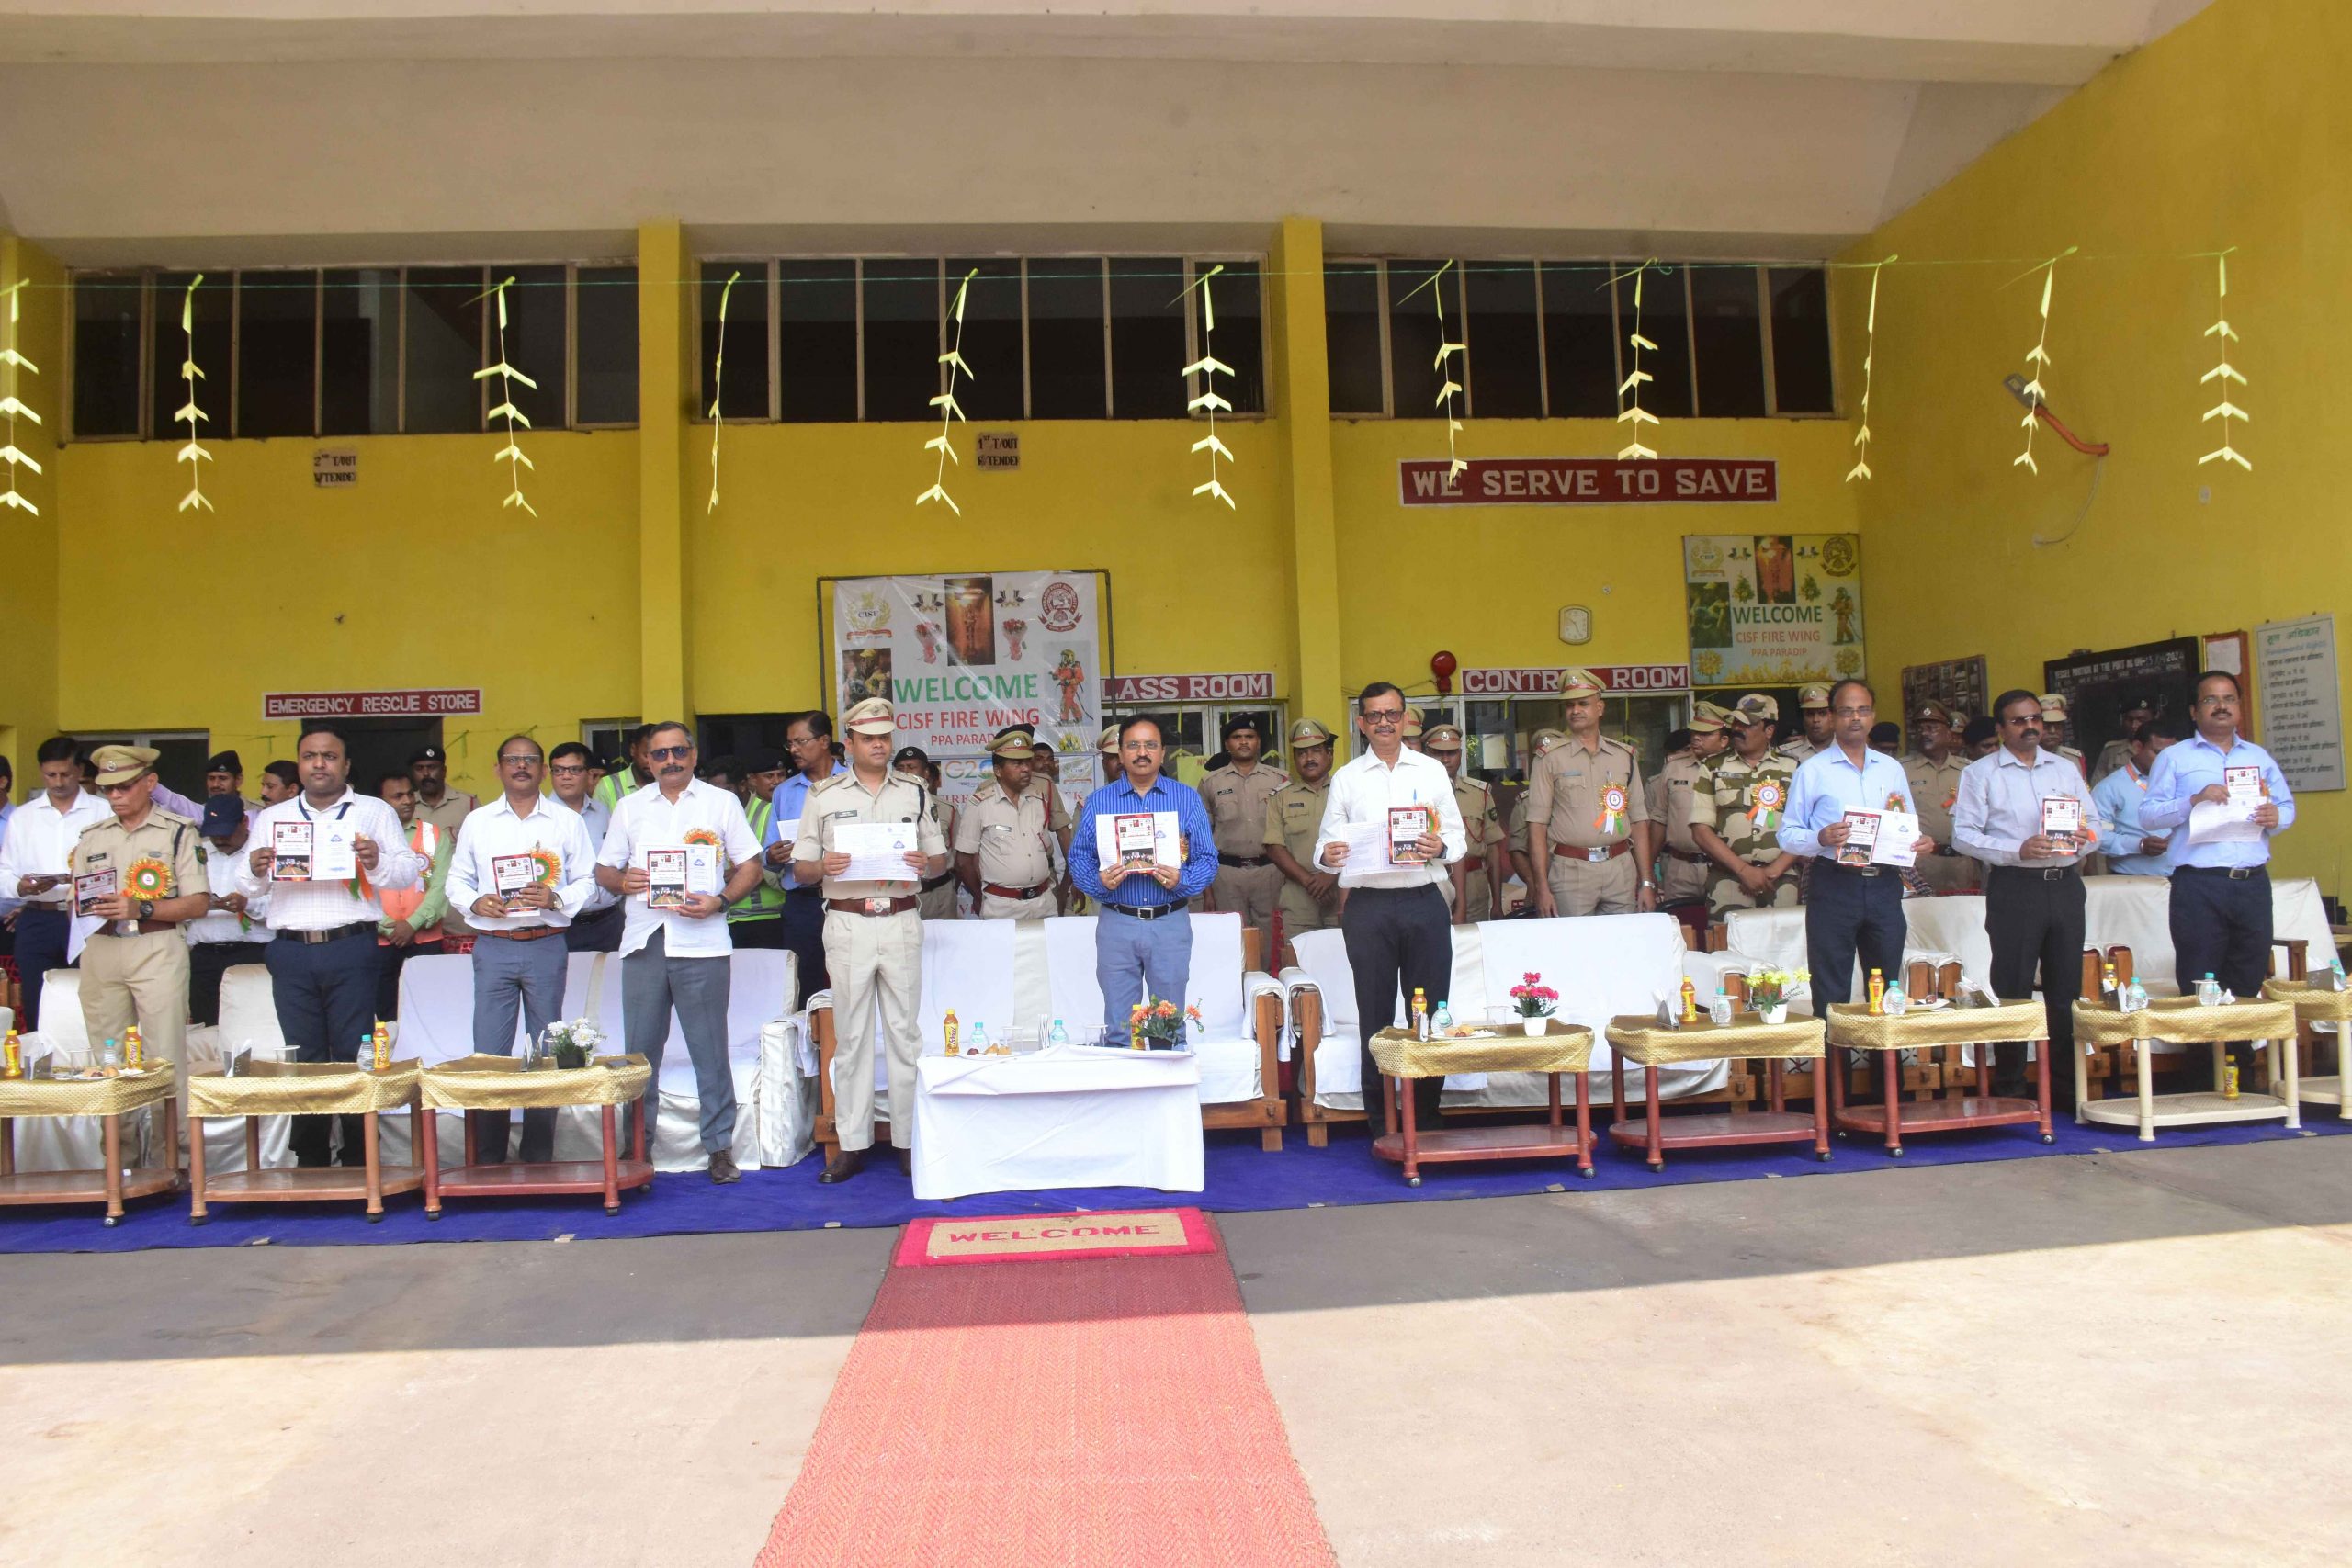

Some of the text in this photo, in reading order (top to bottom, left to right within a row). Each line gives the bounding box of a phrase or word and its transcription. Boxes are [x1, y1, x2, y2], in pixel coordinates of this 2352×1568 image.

[1411, 468, 1768, 497] WE SERVE TO SAVE
[857, 610, 879, 618] CISF
[1733, 605, 1823, 624] WELCOME
[1736, 630, 1821, 643] CISF FIRE WING
[1750, 647, 1807, 657] PPA PARADIP
[894, 674, 1038, 703] WELCOME
[1102, 674, 1269, 700] LASS ROOM
[1465, 667, 1688, 692] CONTR ROOM
[268, 694, 476, 714] EMERGENCY RESCUE STORE
[896, 708, 1040, 729] CISF FIRE WING
[931, 733, 995, 746] PPA PARAD
[948, 1224, 1161, 1243] WELCOME
